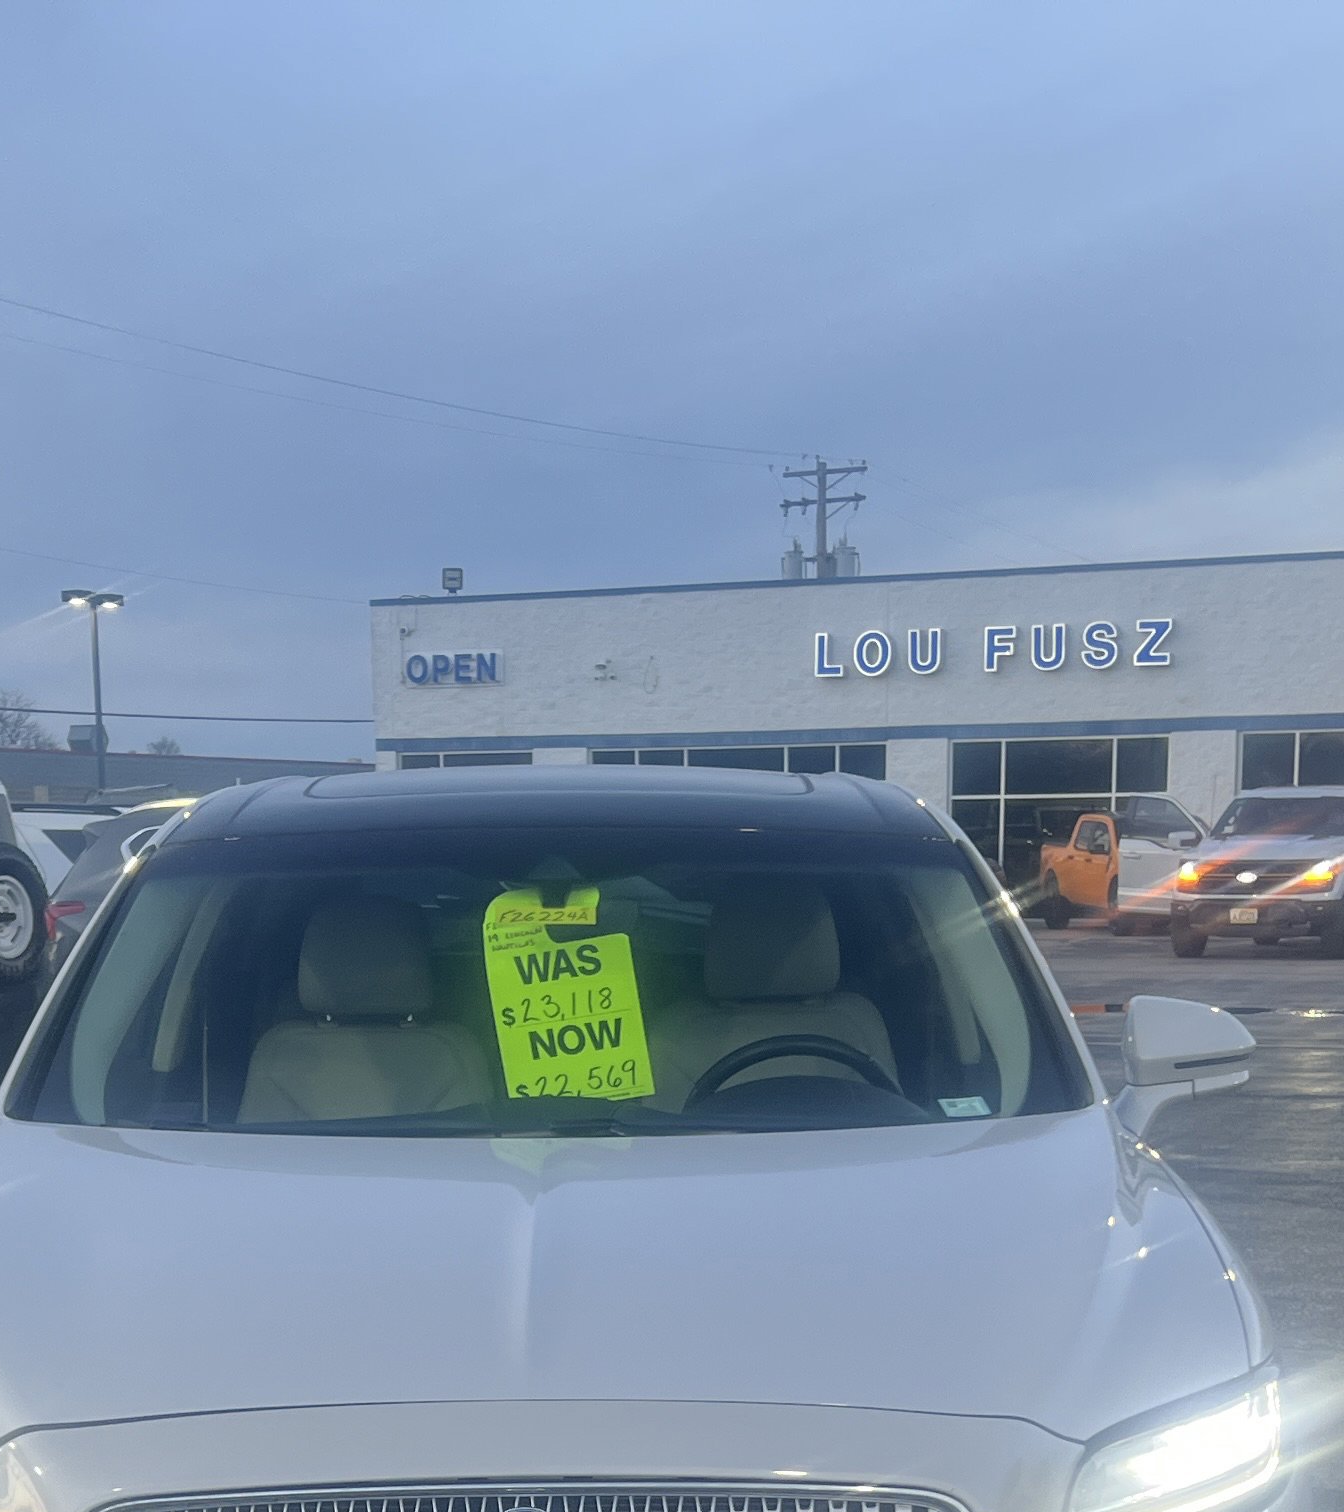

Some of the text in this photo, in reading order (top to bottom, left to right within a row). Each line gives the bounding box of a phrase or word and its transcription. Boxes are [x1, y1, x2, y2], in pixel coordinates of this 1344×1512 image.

[406, 652, 497, 684] OPEN
[814, 618, 1173, 678] LOU FUSZ
[499, 909, 589, 923] F26224A
[513, 944, 603, 985] WAS
[528, 1018, 623, 1060] NOW
